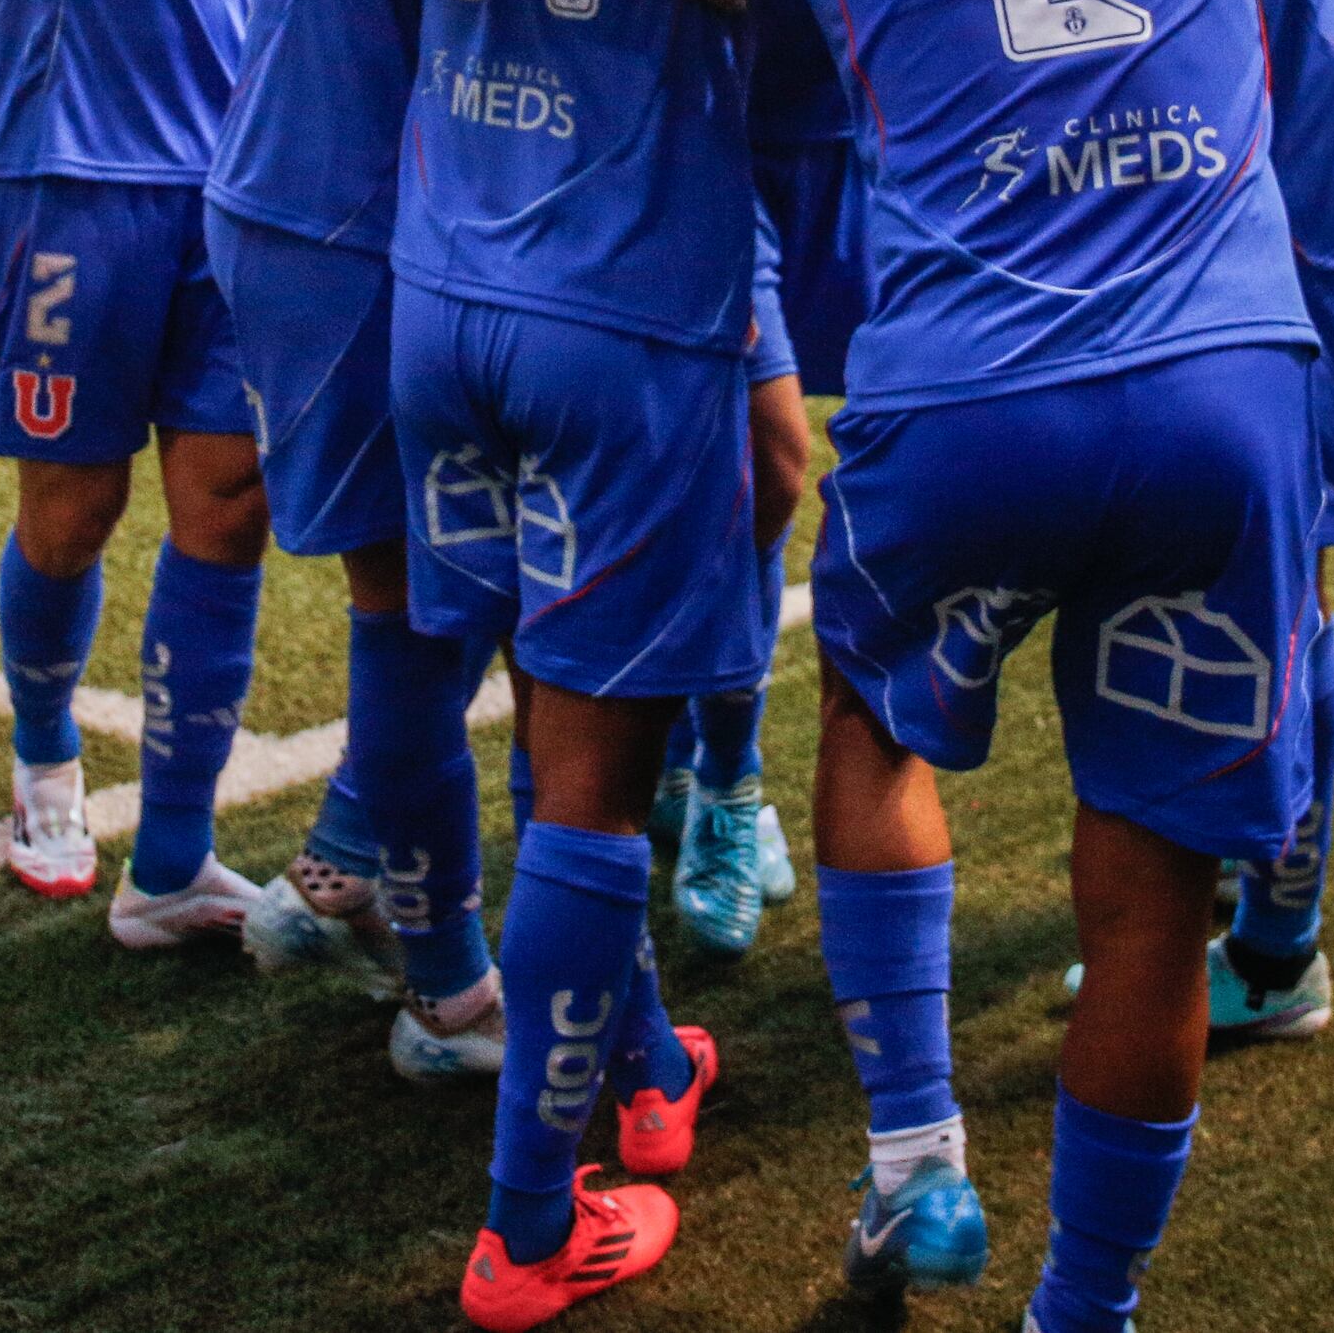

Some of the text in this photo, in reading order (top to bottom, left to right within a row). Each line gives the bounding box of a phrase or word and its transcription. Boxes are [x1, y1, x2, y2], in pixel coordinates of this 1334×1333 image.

[450, 73, 577, 140] MEDS
[1064, 104, 1203, 138] CLINICA
[1046, 126, 1228, 197] MEDS
[25, 253, 78, 345] 2
[13, 370, 76, 440] U
